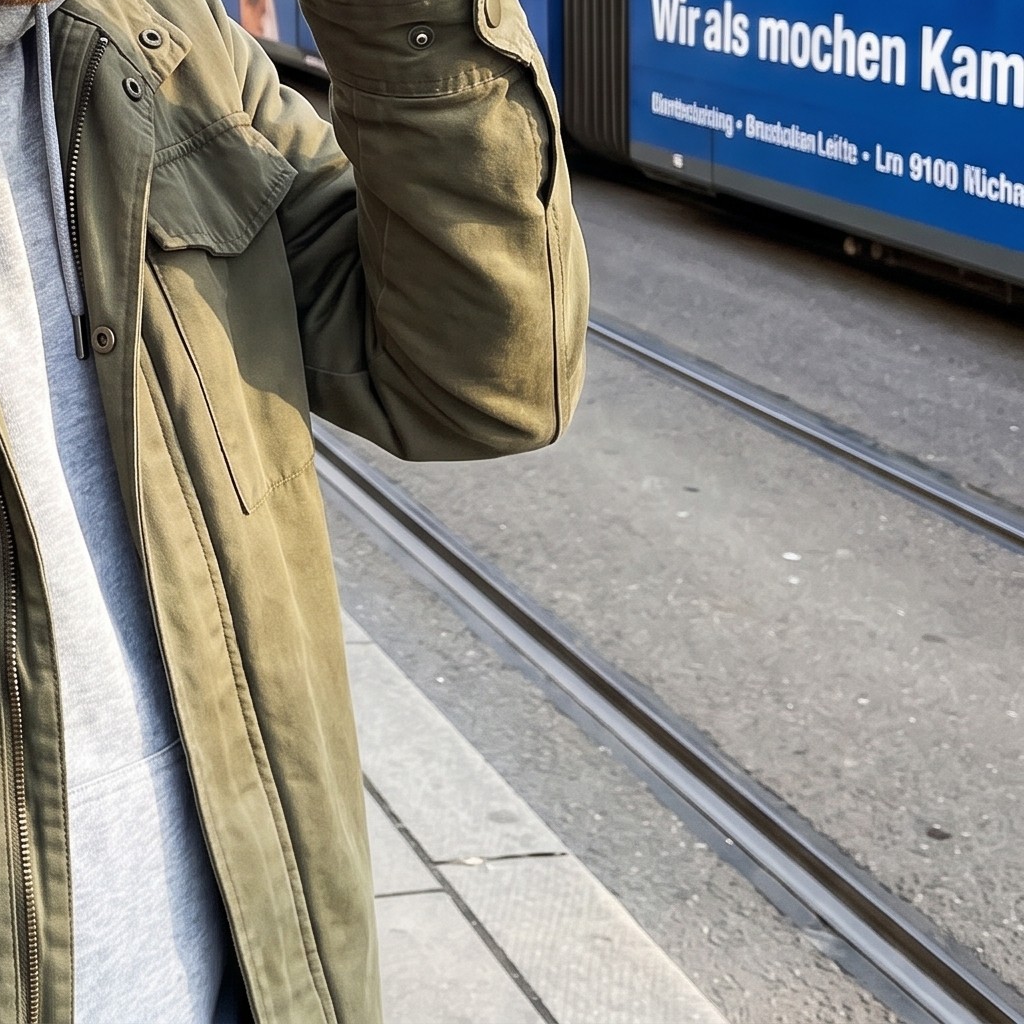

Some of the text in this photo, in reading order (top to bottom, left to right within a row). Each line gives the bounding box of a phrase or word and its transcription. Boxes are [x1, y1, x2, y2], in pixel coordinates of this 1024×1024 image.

[704, 0, 750, 58] als
[758, 13, 906, 87] mochen
[920, 25, 1024, 109] Kam
[909, 151, 958, 191] 9100
